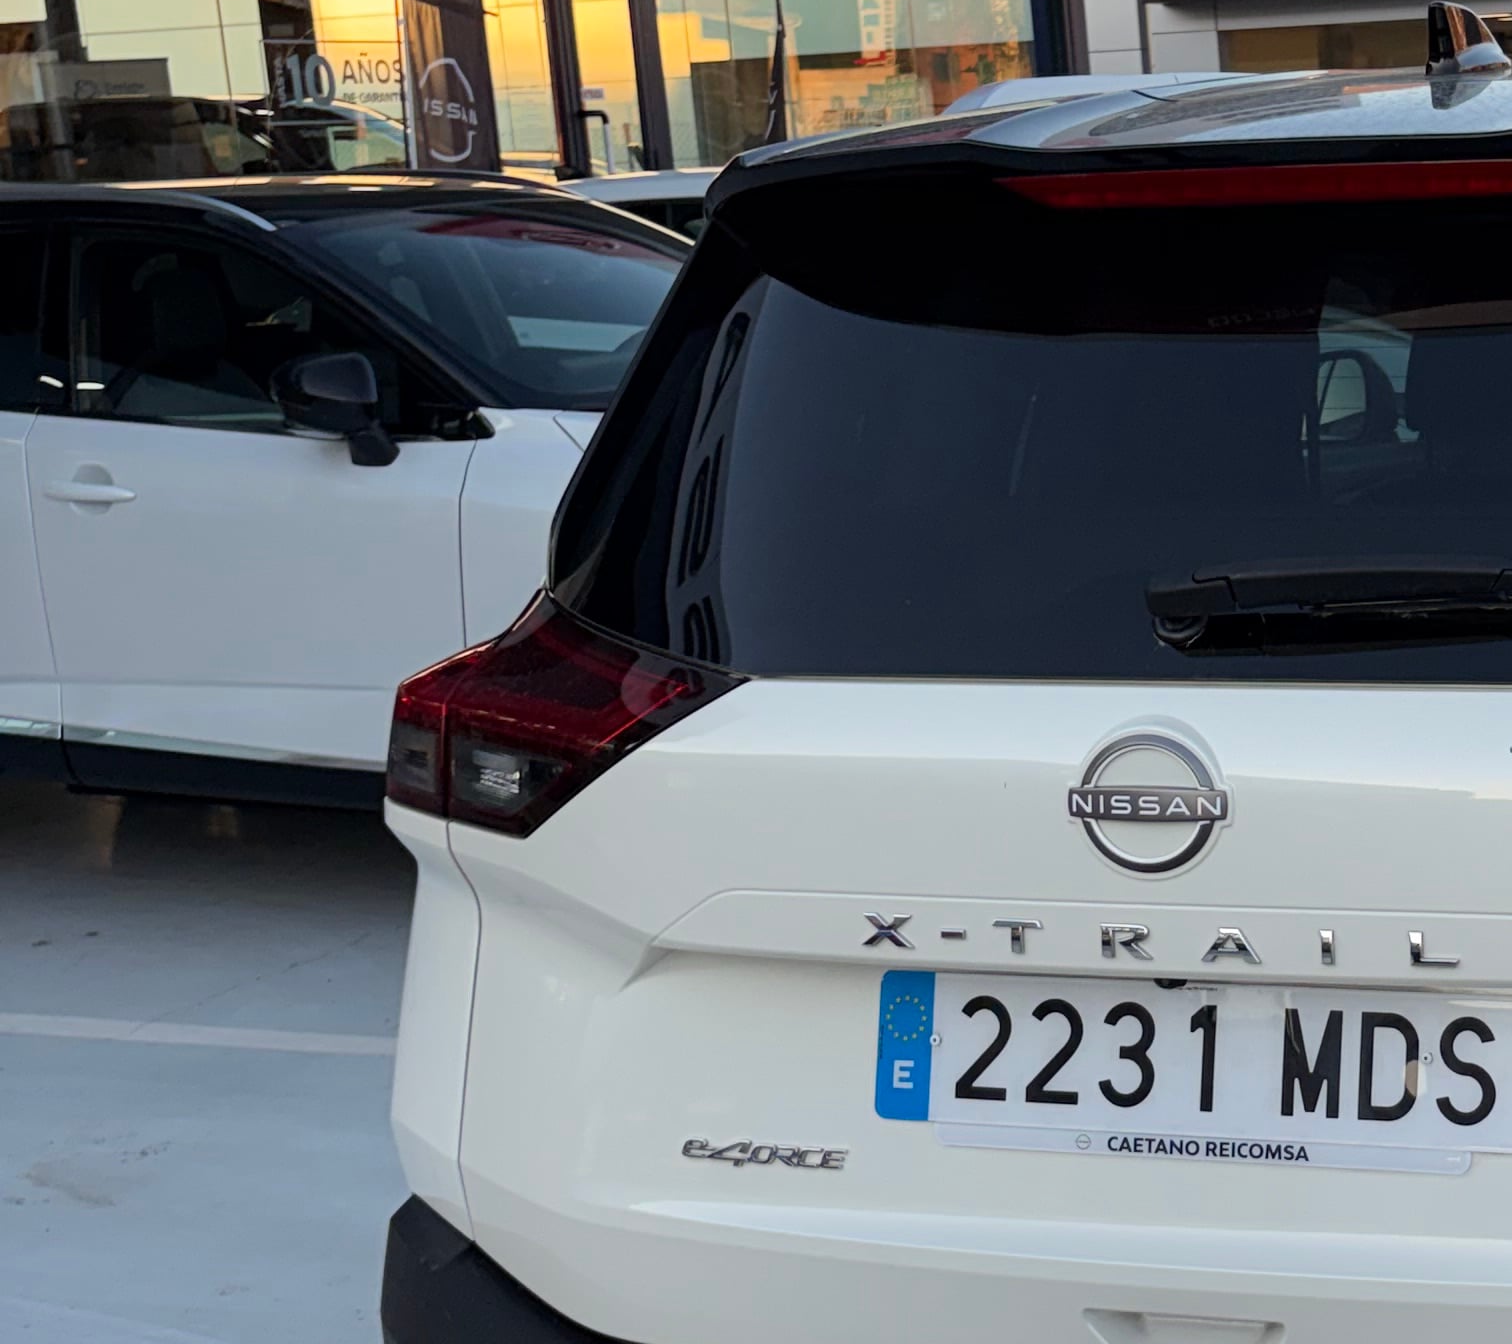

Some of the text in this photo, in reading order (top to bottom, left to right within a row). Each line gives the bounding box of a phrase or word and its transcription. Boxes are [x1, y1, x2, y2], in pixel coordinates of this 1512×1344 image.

[285, 53, 336, 106] 10
[1072, 792, 1223, 818] NISSAN
[862, 911, 1461, 968] X-TRAIL
[892, 994, 1497, 1126] E 2231 MDS
[1107, 1136, 1310, 1162] CAETANO REICOMSA
